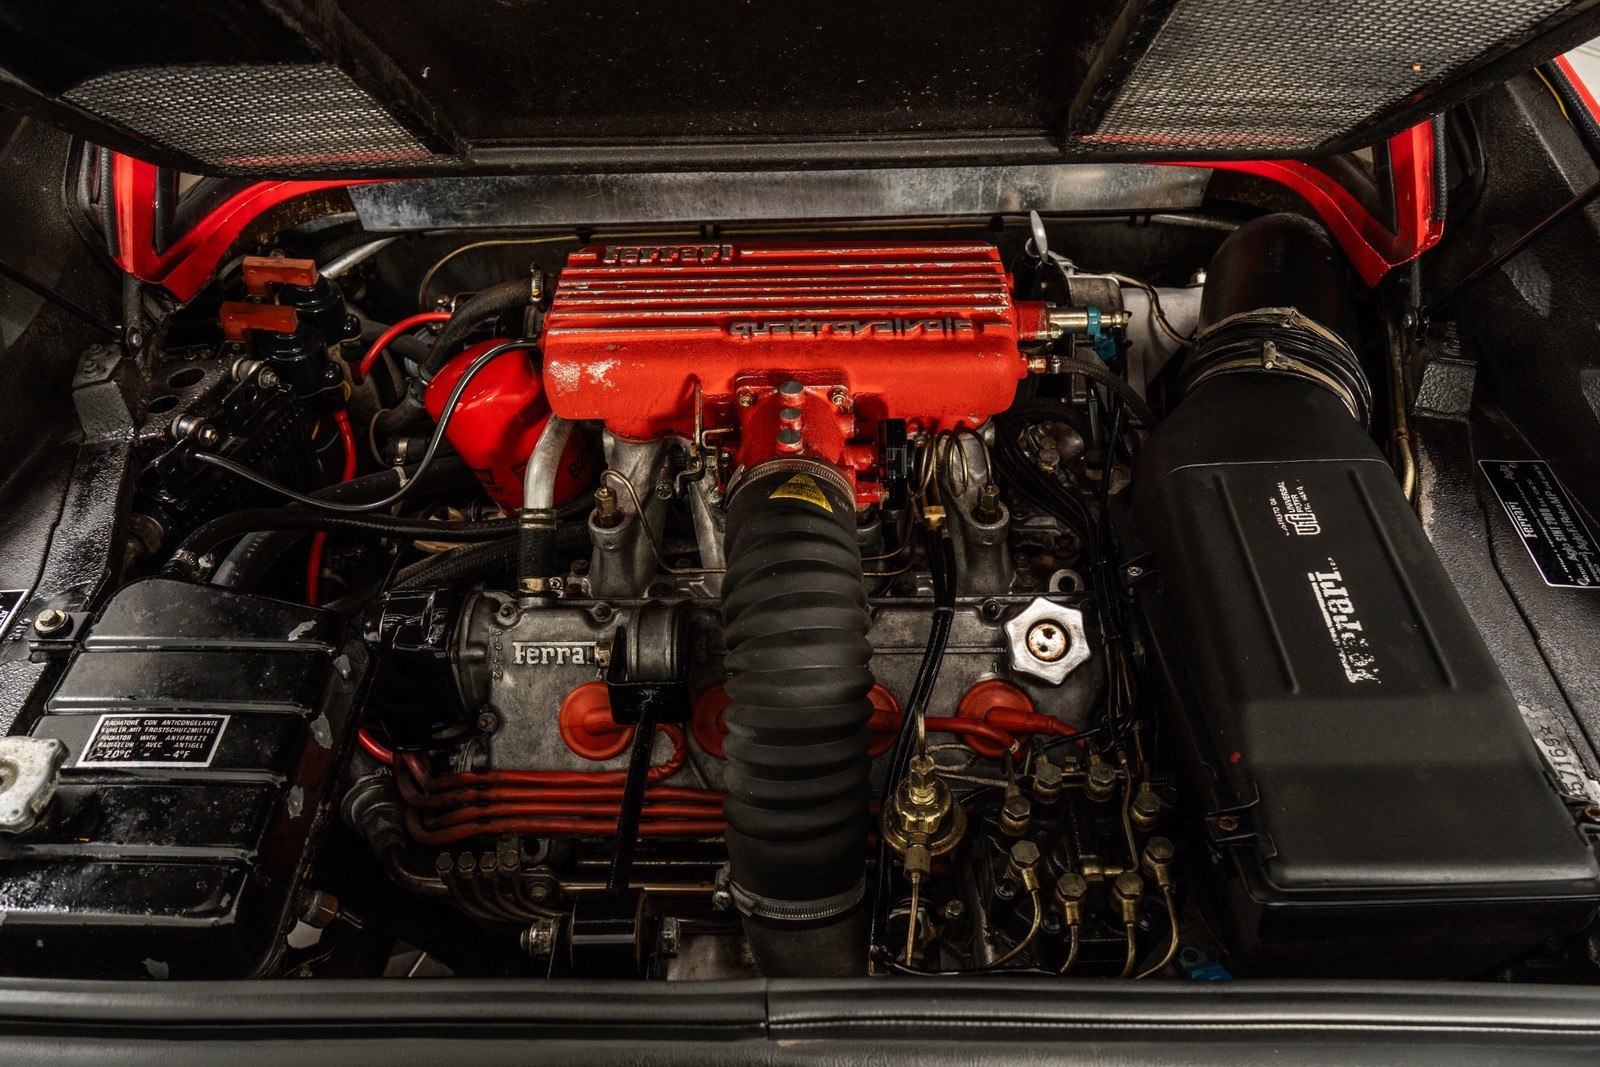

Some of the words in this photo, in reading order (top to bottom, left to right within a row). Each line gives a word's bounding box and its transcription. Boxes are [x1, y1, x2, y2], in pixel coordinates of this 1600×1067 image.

[729, 316, 974, 340] quattrovalvole
[1277, 481, 1296, 513] UNIVERSAL
[1504, 500, 1538, 539] Ferrari
[1538, 508, 1559, 526] 2000
[1548, 526, 1568, 542] SINT
[1561, 542, 1580, 561] Agip
[104, 719, 140, 727] RADIATORE
[143, 719, 158, 727] CON
[161, 719, 218, 728] ANTICONGELANTE
[130, 726, 142, 734] MIT
[144, 726, 215, 735] FROSTSCHUTZMITTEL
[97, 741, 135, 749] RADIATEUR
[144, 741, 163, 749] AVEC
[173, 742, 204, 750] ANTIGEL
[100, 734, 132, 742] RADIATOR
[140, 734, 157, 742] WITH
[165, 735, 207, 743] ANTIFREEZE
